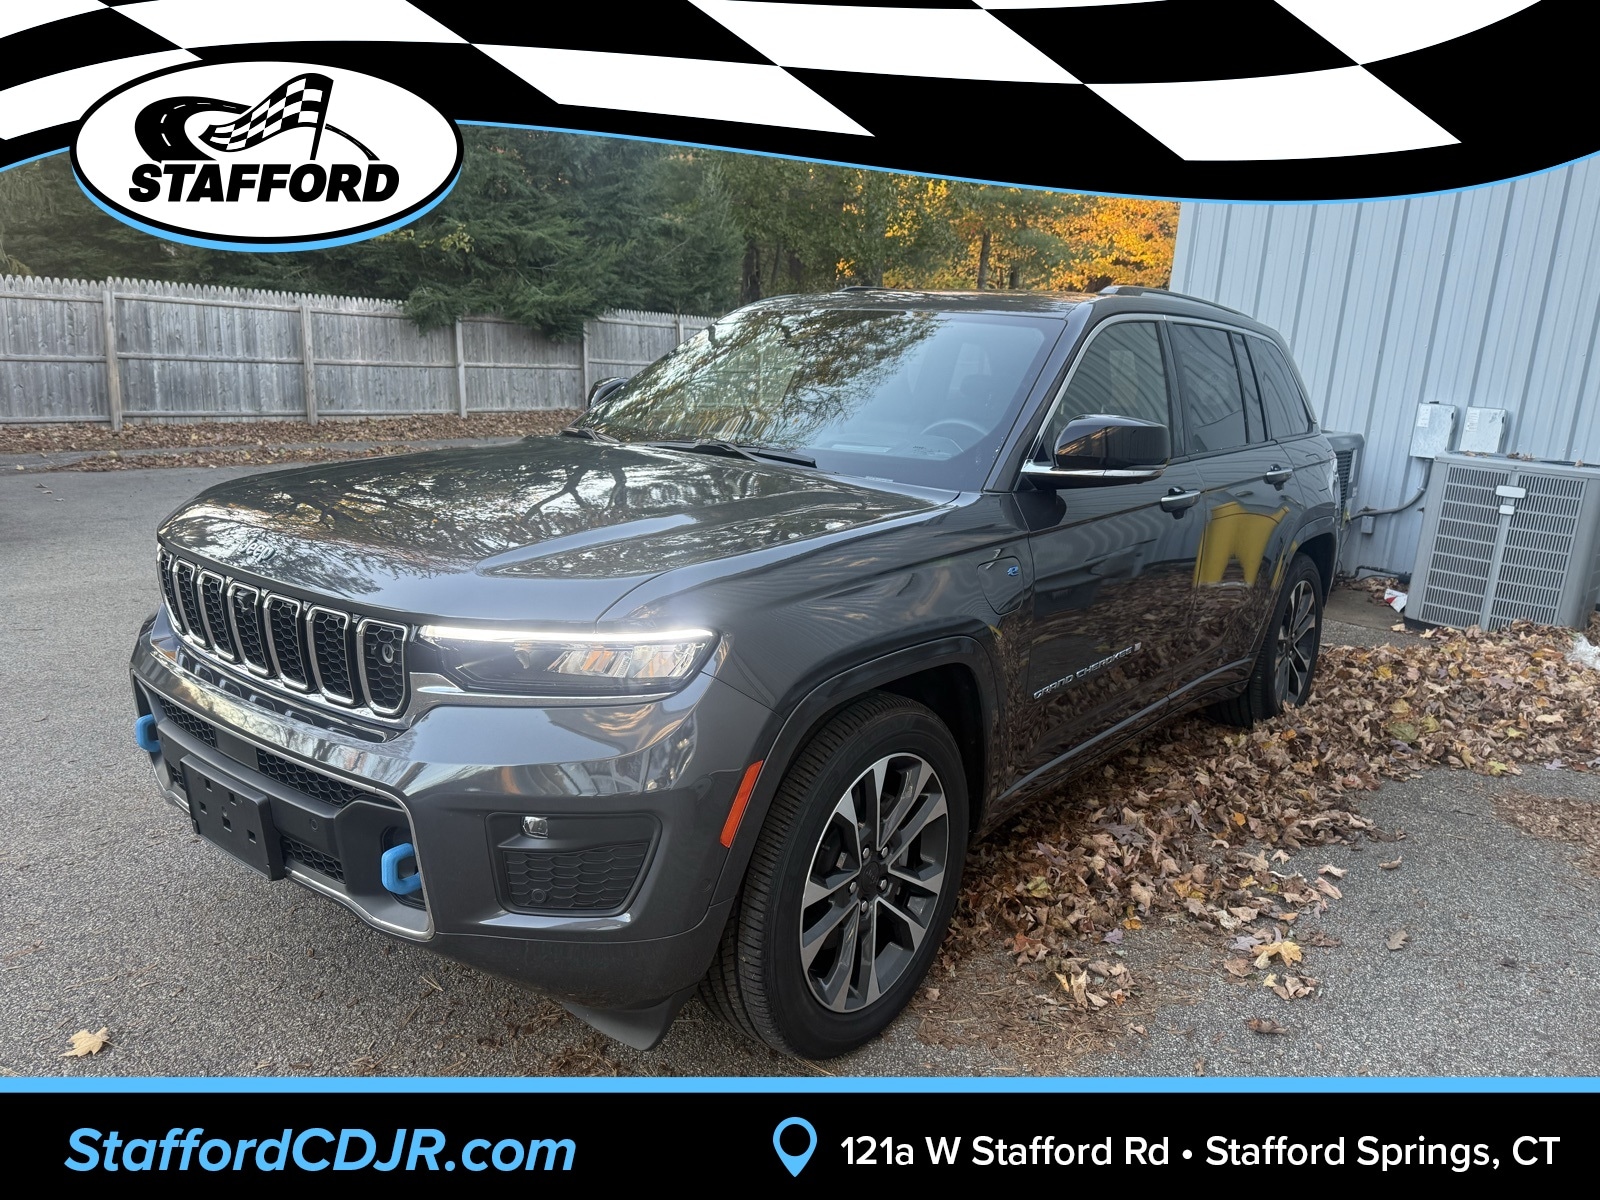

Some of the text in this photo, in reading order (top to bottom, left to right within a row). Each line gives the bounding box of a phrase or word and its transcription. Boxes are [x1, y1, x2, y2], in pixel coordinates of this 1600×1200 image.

[238, 539, 275, 562] Jeep
[1033, 646, 1133, 699] GRAND CHEROKEE
